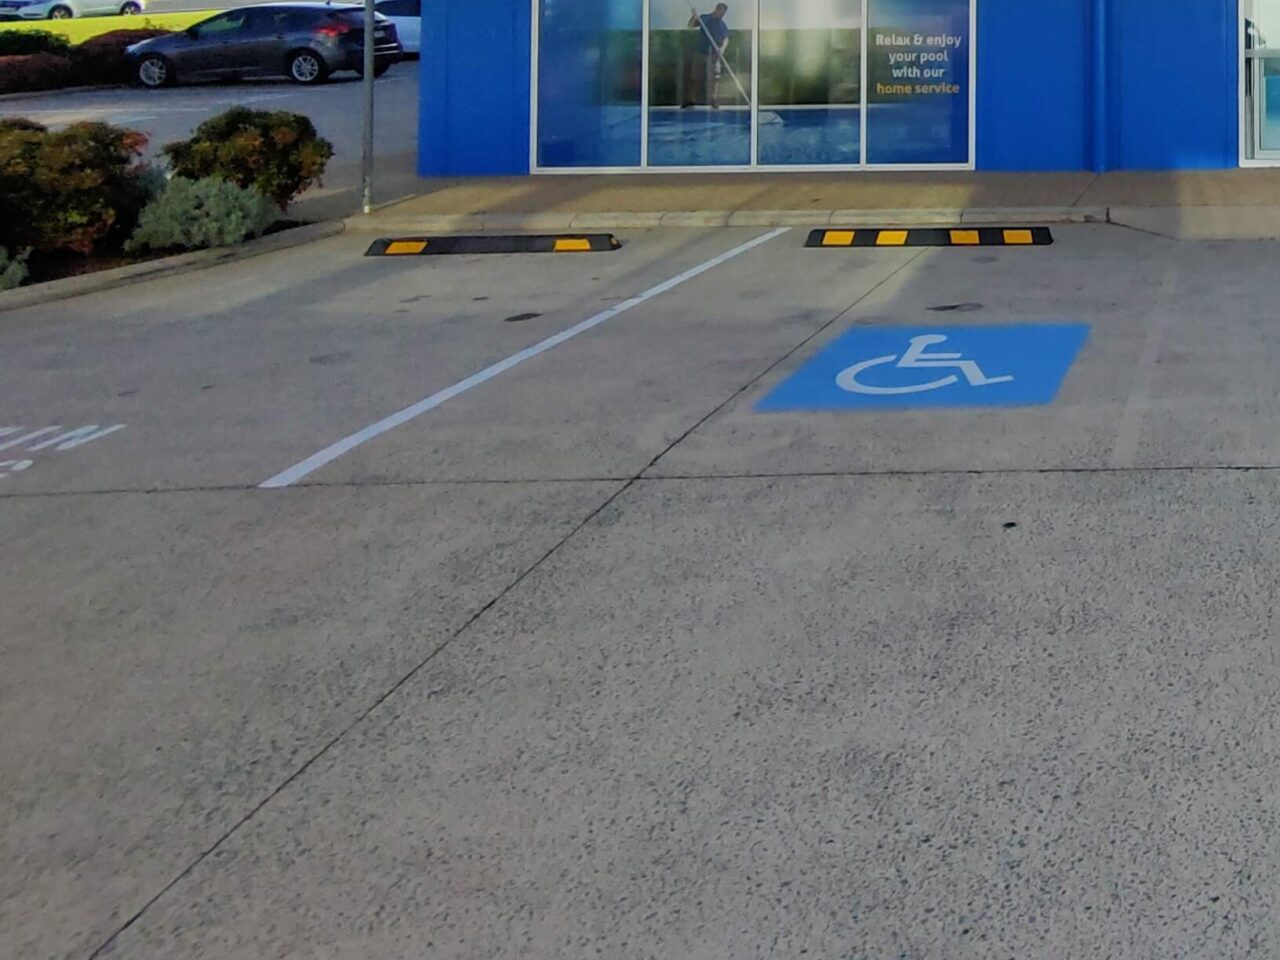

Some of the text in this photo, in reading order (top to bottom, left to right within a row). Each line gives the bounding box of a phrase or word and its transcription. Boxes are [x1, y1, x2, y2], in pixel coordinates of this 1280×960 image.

[875, 33, 962, 49] Relax & enjoy
[888, 49, 949, 65] your pool
[891, 65, 945, 78] with our
[876, 82, 960, 94] home service
